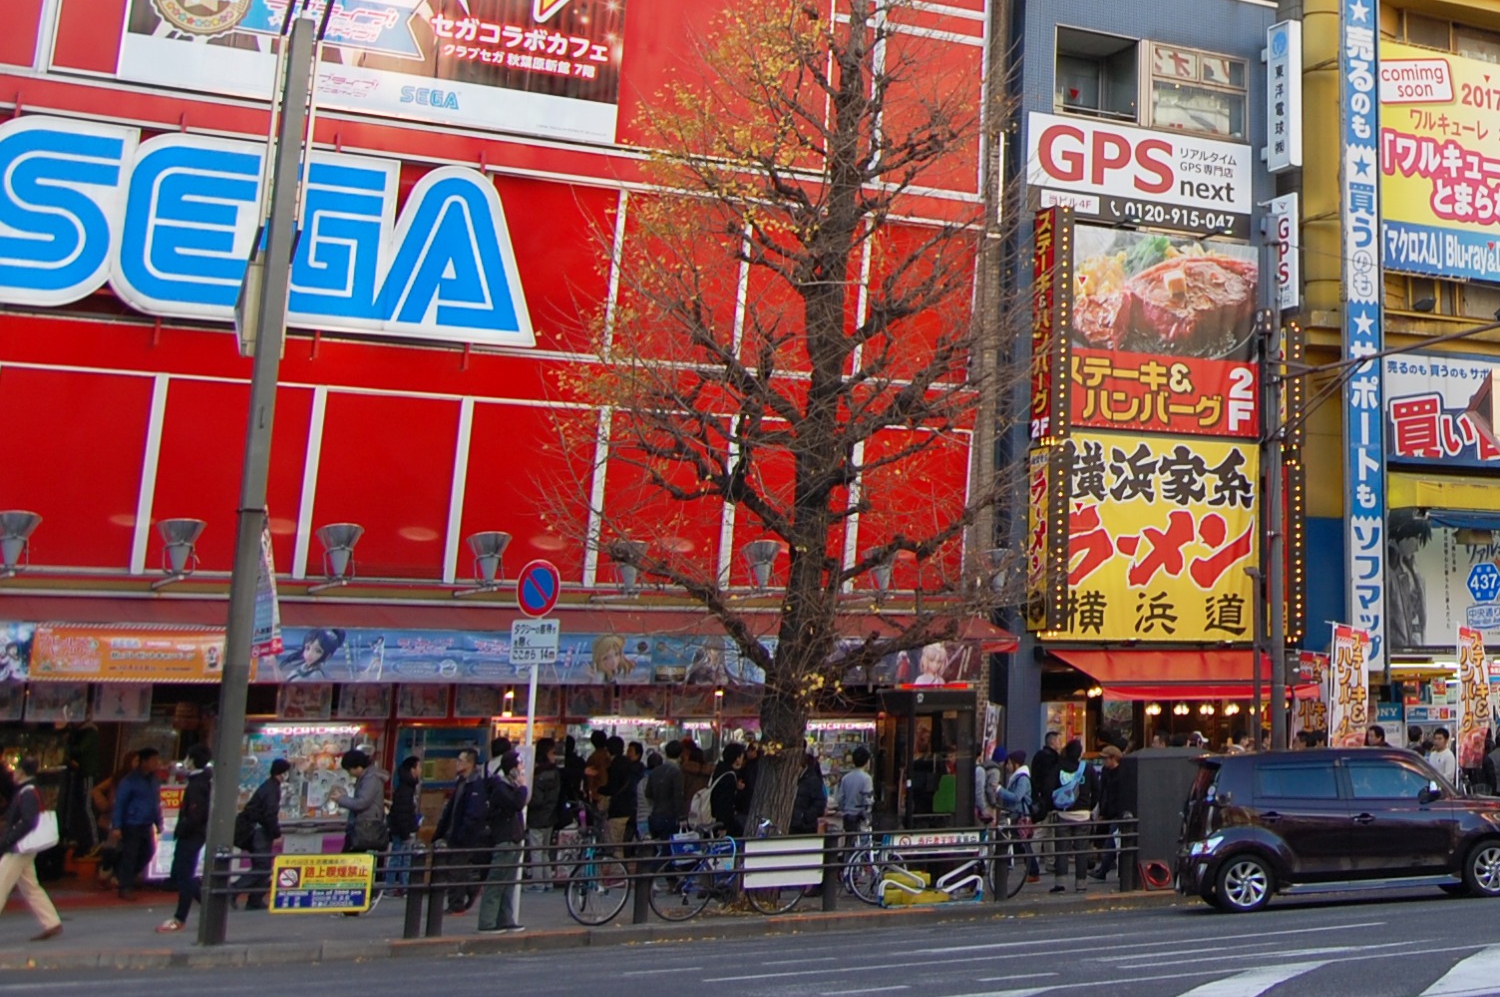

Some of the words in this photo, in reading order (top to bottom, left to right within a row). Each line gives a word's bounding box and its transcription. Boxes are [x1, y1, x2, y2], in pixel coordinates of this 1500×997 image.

[431, 14, 611, 63] セガコラボカフェ
[442, 43, 506, 66] クラブセガ
[507, 49, 571, 76] 秋葉原新館
[400, 84, 460, 110] SEGA
[1346, 26, 1375, 139] 売るのも
[1397, 83, 1434, 98] soon
[1409, 109, 1489, 141] ワルキューレ
[1038, 124, 1175, 195] GPS
[1179, 146, 1238, 167] リアルタイム
[1179, 178, 1236, 203] next
[0, 116, 535, 346] SEGA
[1124, 201, 1236, 231] 0120-915-047
[1348, 182, 1376, 297] 買うのも
[1387, 360, 1427, 375] 売るのも
[1430, 364, 1467, 378] 買うのも
[1031, 416, 1050, 438] 2F
[1082, 390, 1223, 426] ハンバーグ
[1350, 339, 1380, 508] サポートも
[1064, 440, 1256, 509] 横浜家系
[1068, 505, 1255, 590] ラーメン
[1352, 519, 1382, 662] ソフマップ
[1470, 573, 1499, 590] 437
[1066, 590, 1248, 635] 横浜道
[1468, 607, 1500, 618] 中央通り
[1350, 633, 1367, 724] ステーキ&
[1459, 645, 1476, 732] ハンバーグ
[1469, 632, 1490, 718] ステーキ&
